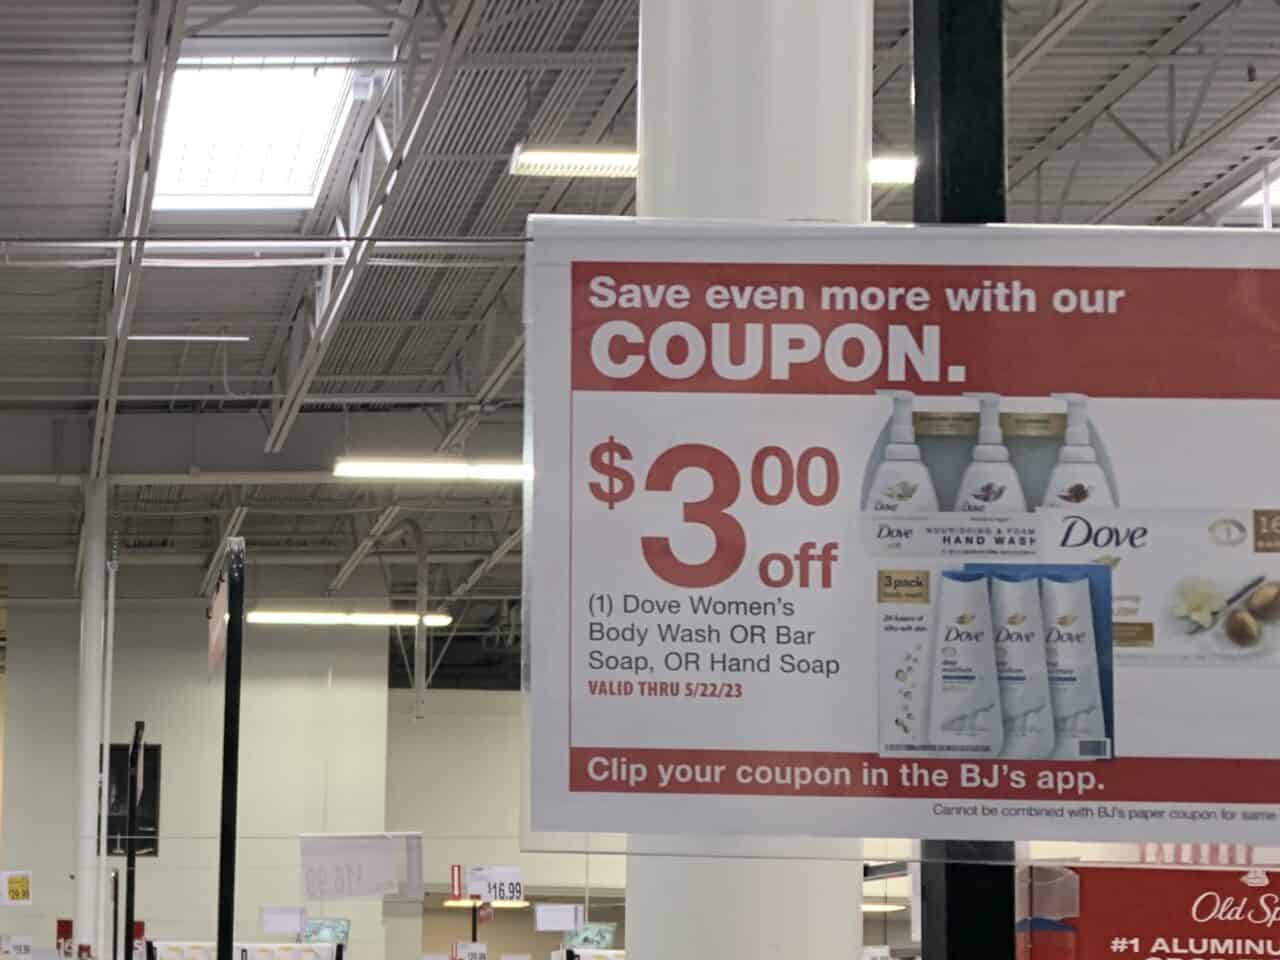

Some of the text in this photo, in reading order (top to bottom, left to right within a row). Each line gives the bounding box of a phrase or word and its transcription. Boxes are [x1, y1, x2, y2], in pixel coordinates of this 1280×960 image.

[589, 276, 1125, 314] Save even more with our
[590, 321, 966, 382] COUPON.
[877, 524, 913, 540] Dove
[1061, 515, 1148, 548] Dove
[942, 536, 986, 546] HAND
[758, 542, 840, 588] off
[884, 576, 923, 589] 3 pack
[588, 593, 795, 618] (1) Dove Women's
[588, 622, 816, 648] Body Wash OR Bar
[944, 626, 984, 642] Dove
[995, 627, 1034, 642] Dove
[1045, 627, 1086, 643] Dove
[588, 651, 840, 680] Soap, OR Hand Soap
[588, 680, 743, 698] VALID THRU 5/22/23
[587, 757, 1105, 796] Clip your coupon in the BJ's app.
[933, 804, 1277, 821] Cannot be combined with BJ's paper coupon for same
[488, 882, 522, 900] $16.99
[1192, 891, 1244, 923] Old
[1110, 937, 1140, 954] #1
